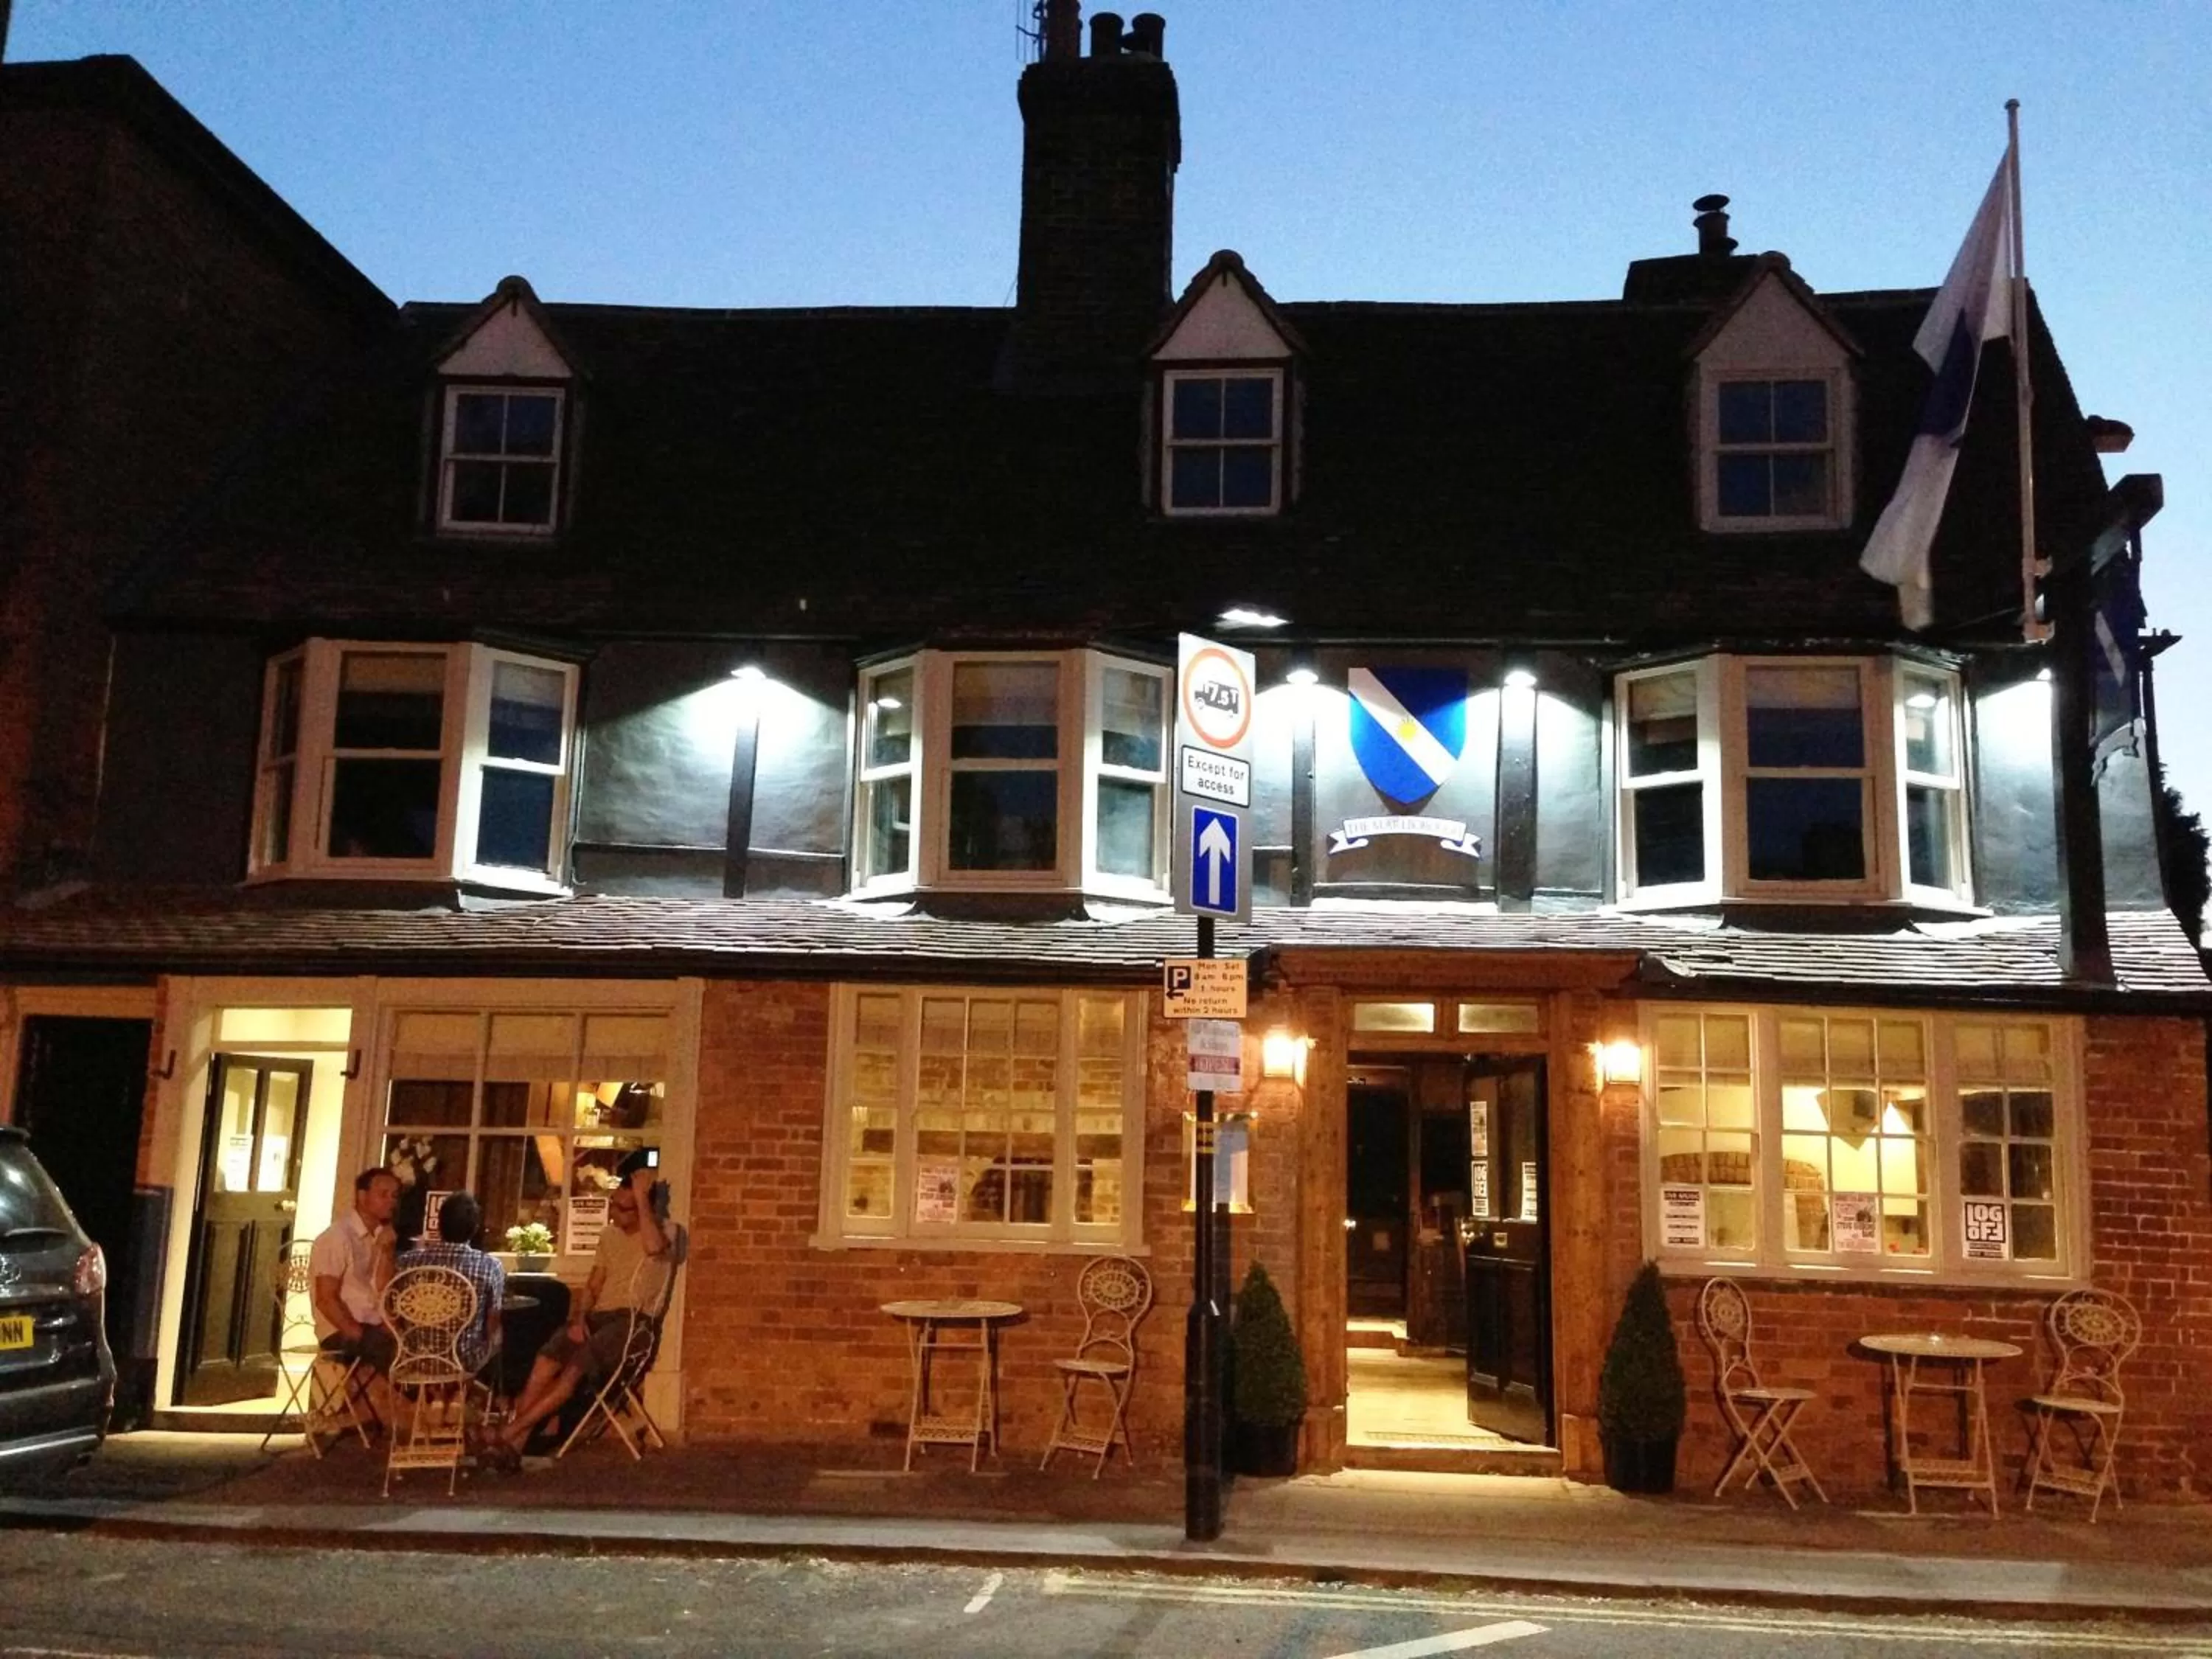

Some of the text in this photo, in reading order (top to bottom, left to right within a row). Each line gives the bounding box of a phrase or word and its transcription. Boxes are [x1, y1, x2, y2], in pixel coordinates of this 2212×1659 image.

[1188, 754, 1245, 781] Except for
[1197, 777, 1234, 795] access
[1173, 968, 1188, 988] P
[1183, 996, 1196, 1004] No
[1966, 1204, 2003, 1226] LOG
